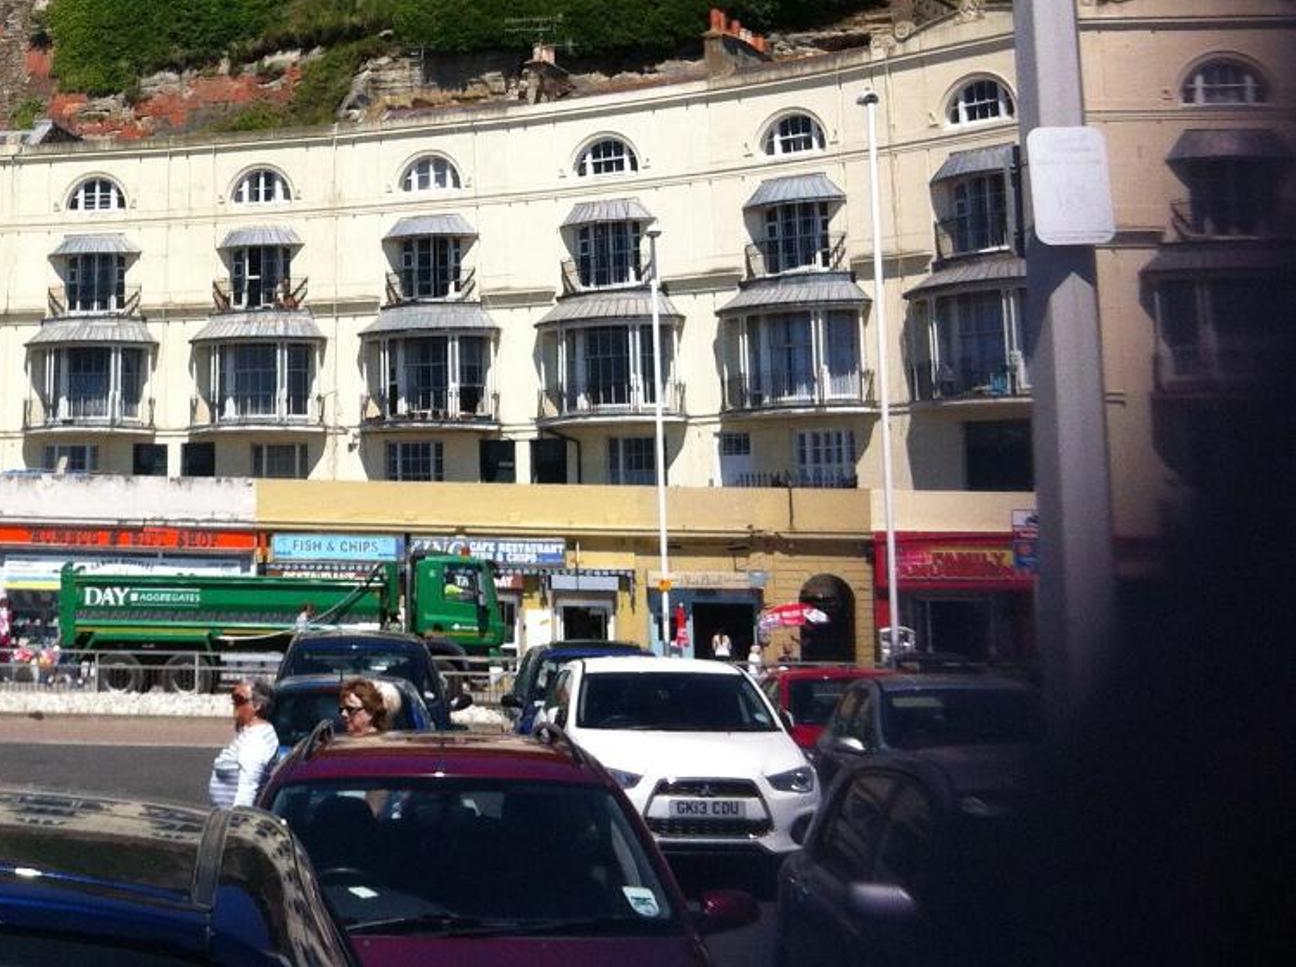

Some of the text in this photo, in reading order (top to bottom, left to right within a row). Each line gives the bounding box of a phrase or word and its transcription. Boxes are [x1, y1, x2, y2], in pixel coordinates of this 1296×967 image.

[292, 539, 379, 553] FISH & CHIPS
[499, 542, 565, 554] RESTAURANT
[506, 552, 538, 563] CHIPS
[84, 586, 201, 607] DAY AGGREGATES
[676, 800, 708, 815] GK13
